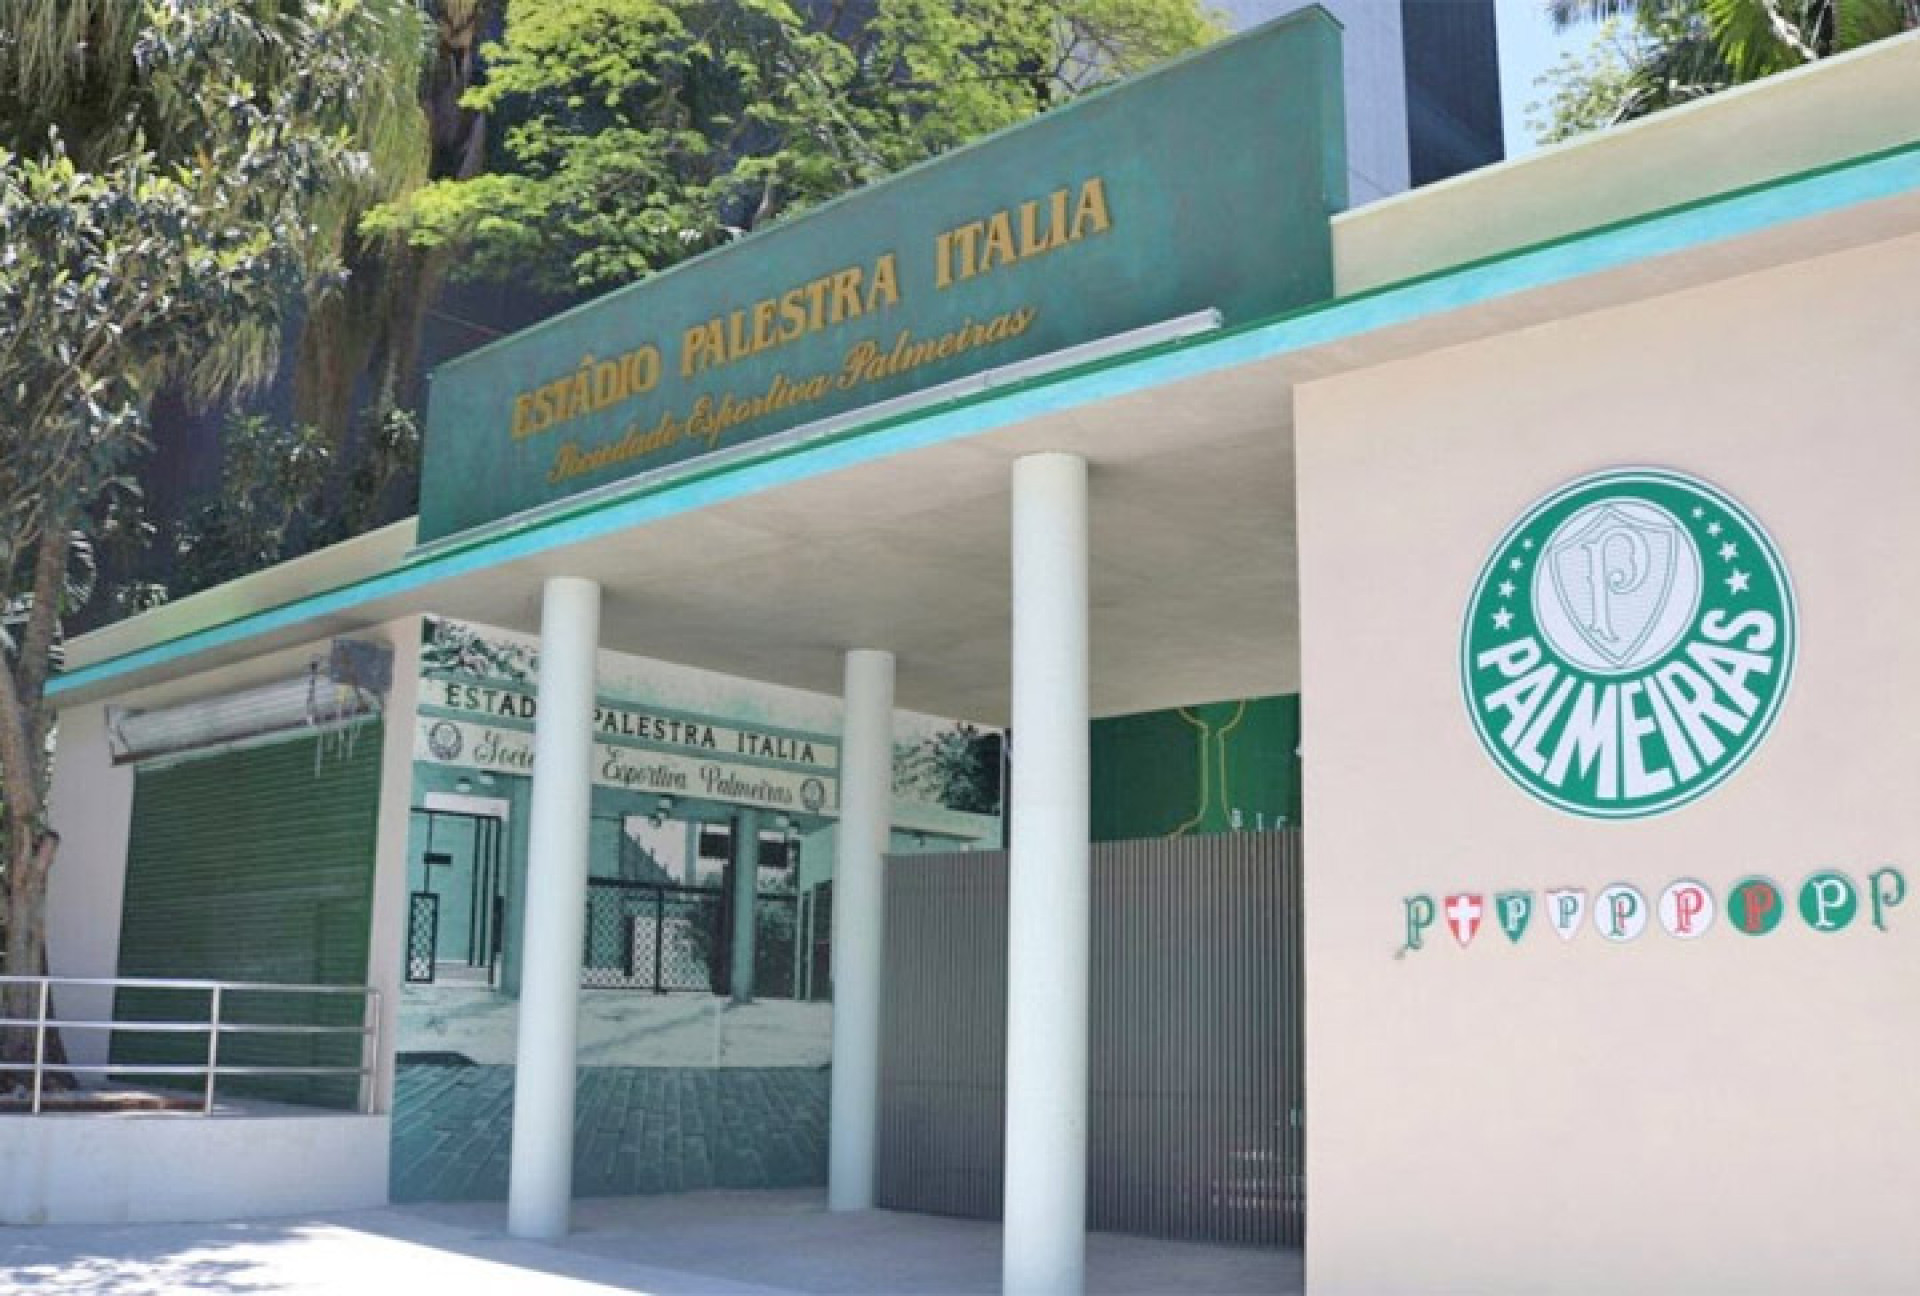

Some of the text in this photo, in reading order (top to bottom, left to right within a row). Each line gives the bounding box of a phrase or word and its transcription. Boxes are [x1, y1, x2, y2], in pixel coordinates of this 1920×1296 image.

[681, 252, 899, 377] PALESTRA
[934, 176, 1111, 289] ITALIA
[835, 305, 1036, 388] Palmeiras
[445, 682, 537, 718] ESTAD
[737, 731, 815, 764] ITALIA
[1477, 609, 1777, 800] PALMEIRAS
